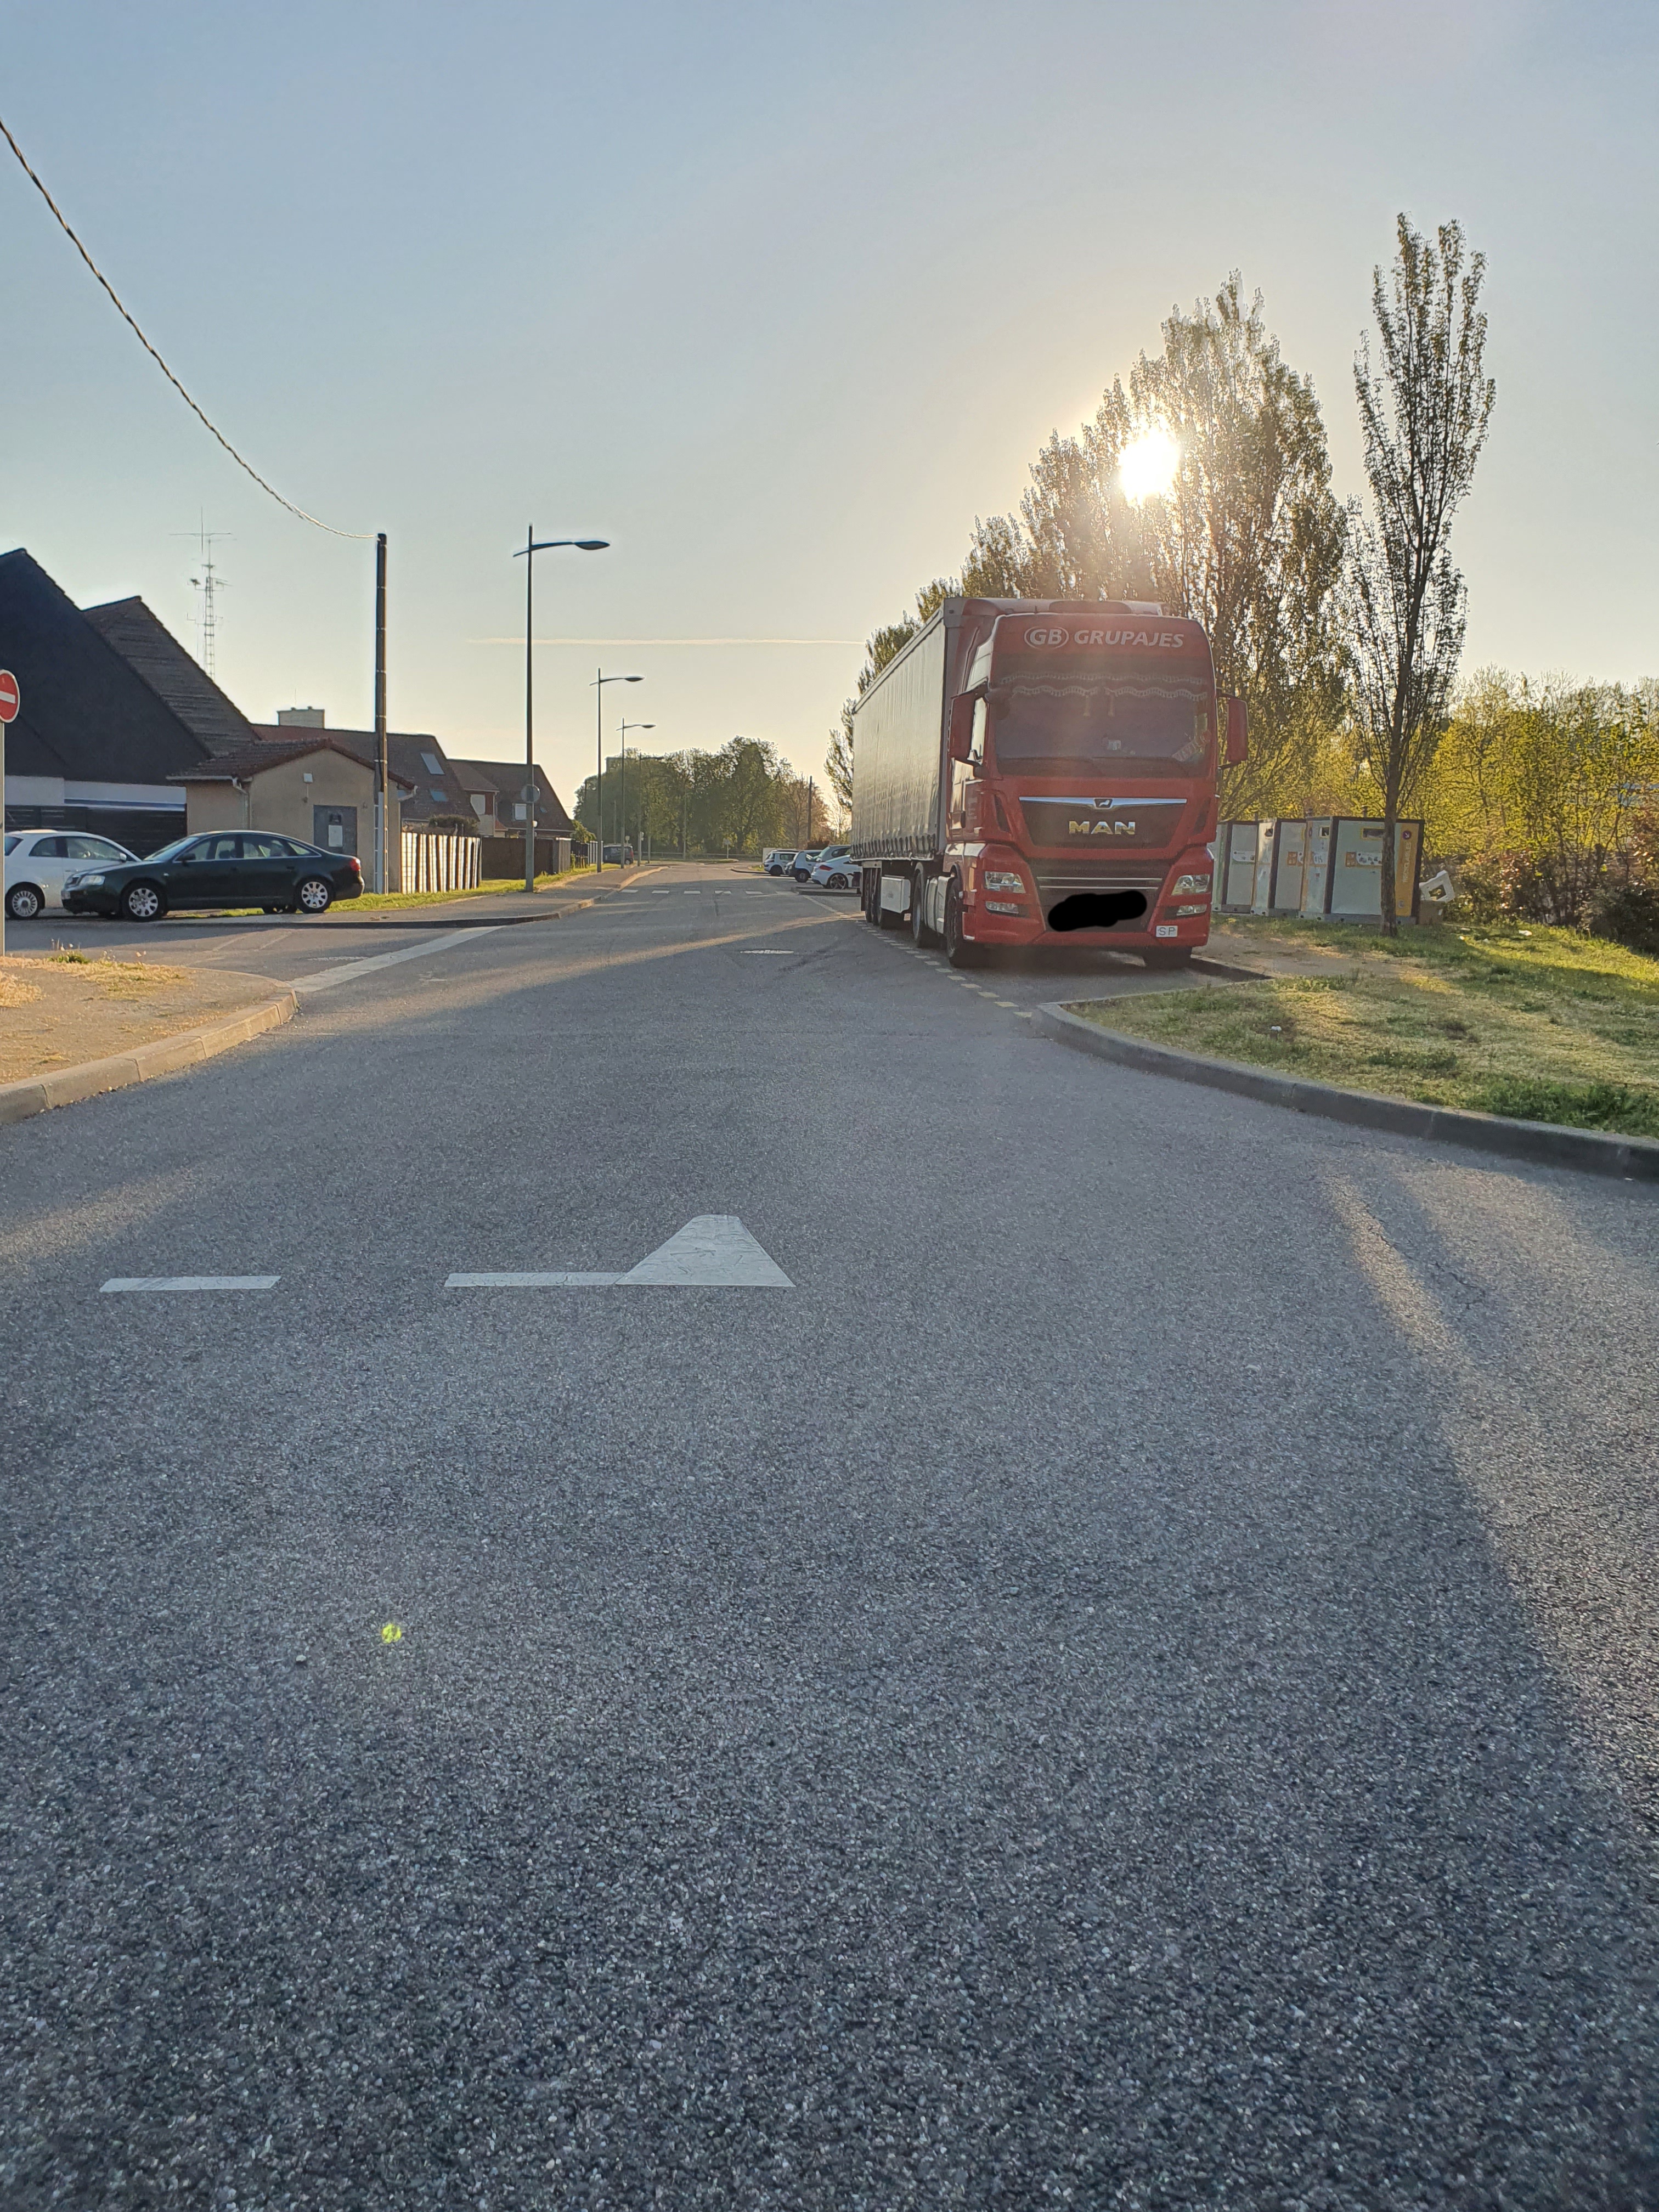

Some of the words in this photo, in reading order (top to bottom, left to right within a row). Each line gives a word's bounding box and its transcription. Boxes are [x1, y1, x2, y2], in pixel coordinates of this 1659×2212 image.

[1029, 628, 1063, 645] GB
[1074, 629, 1185, 648] GRUPAJES
[1069, 820, 1136, 835] MAN
[1159, 927, 1175, 936] SP
